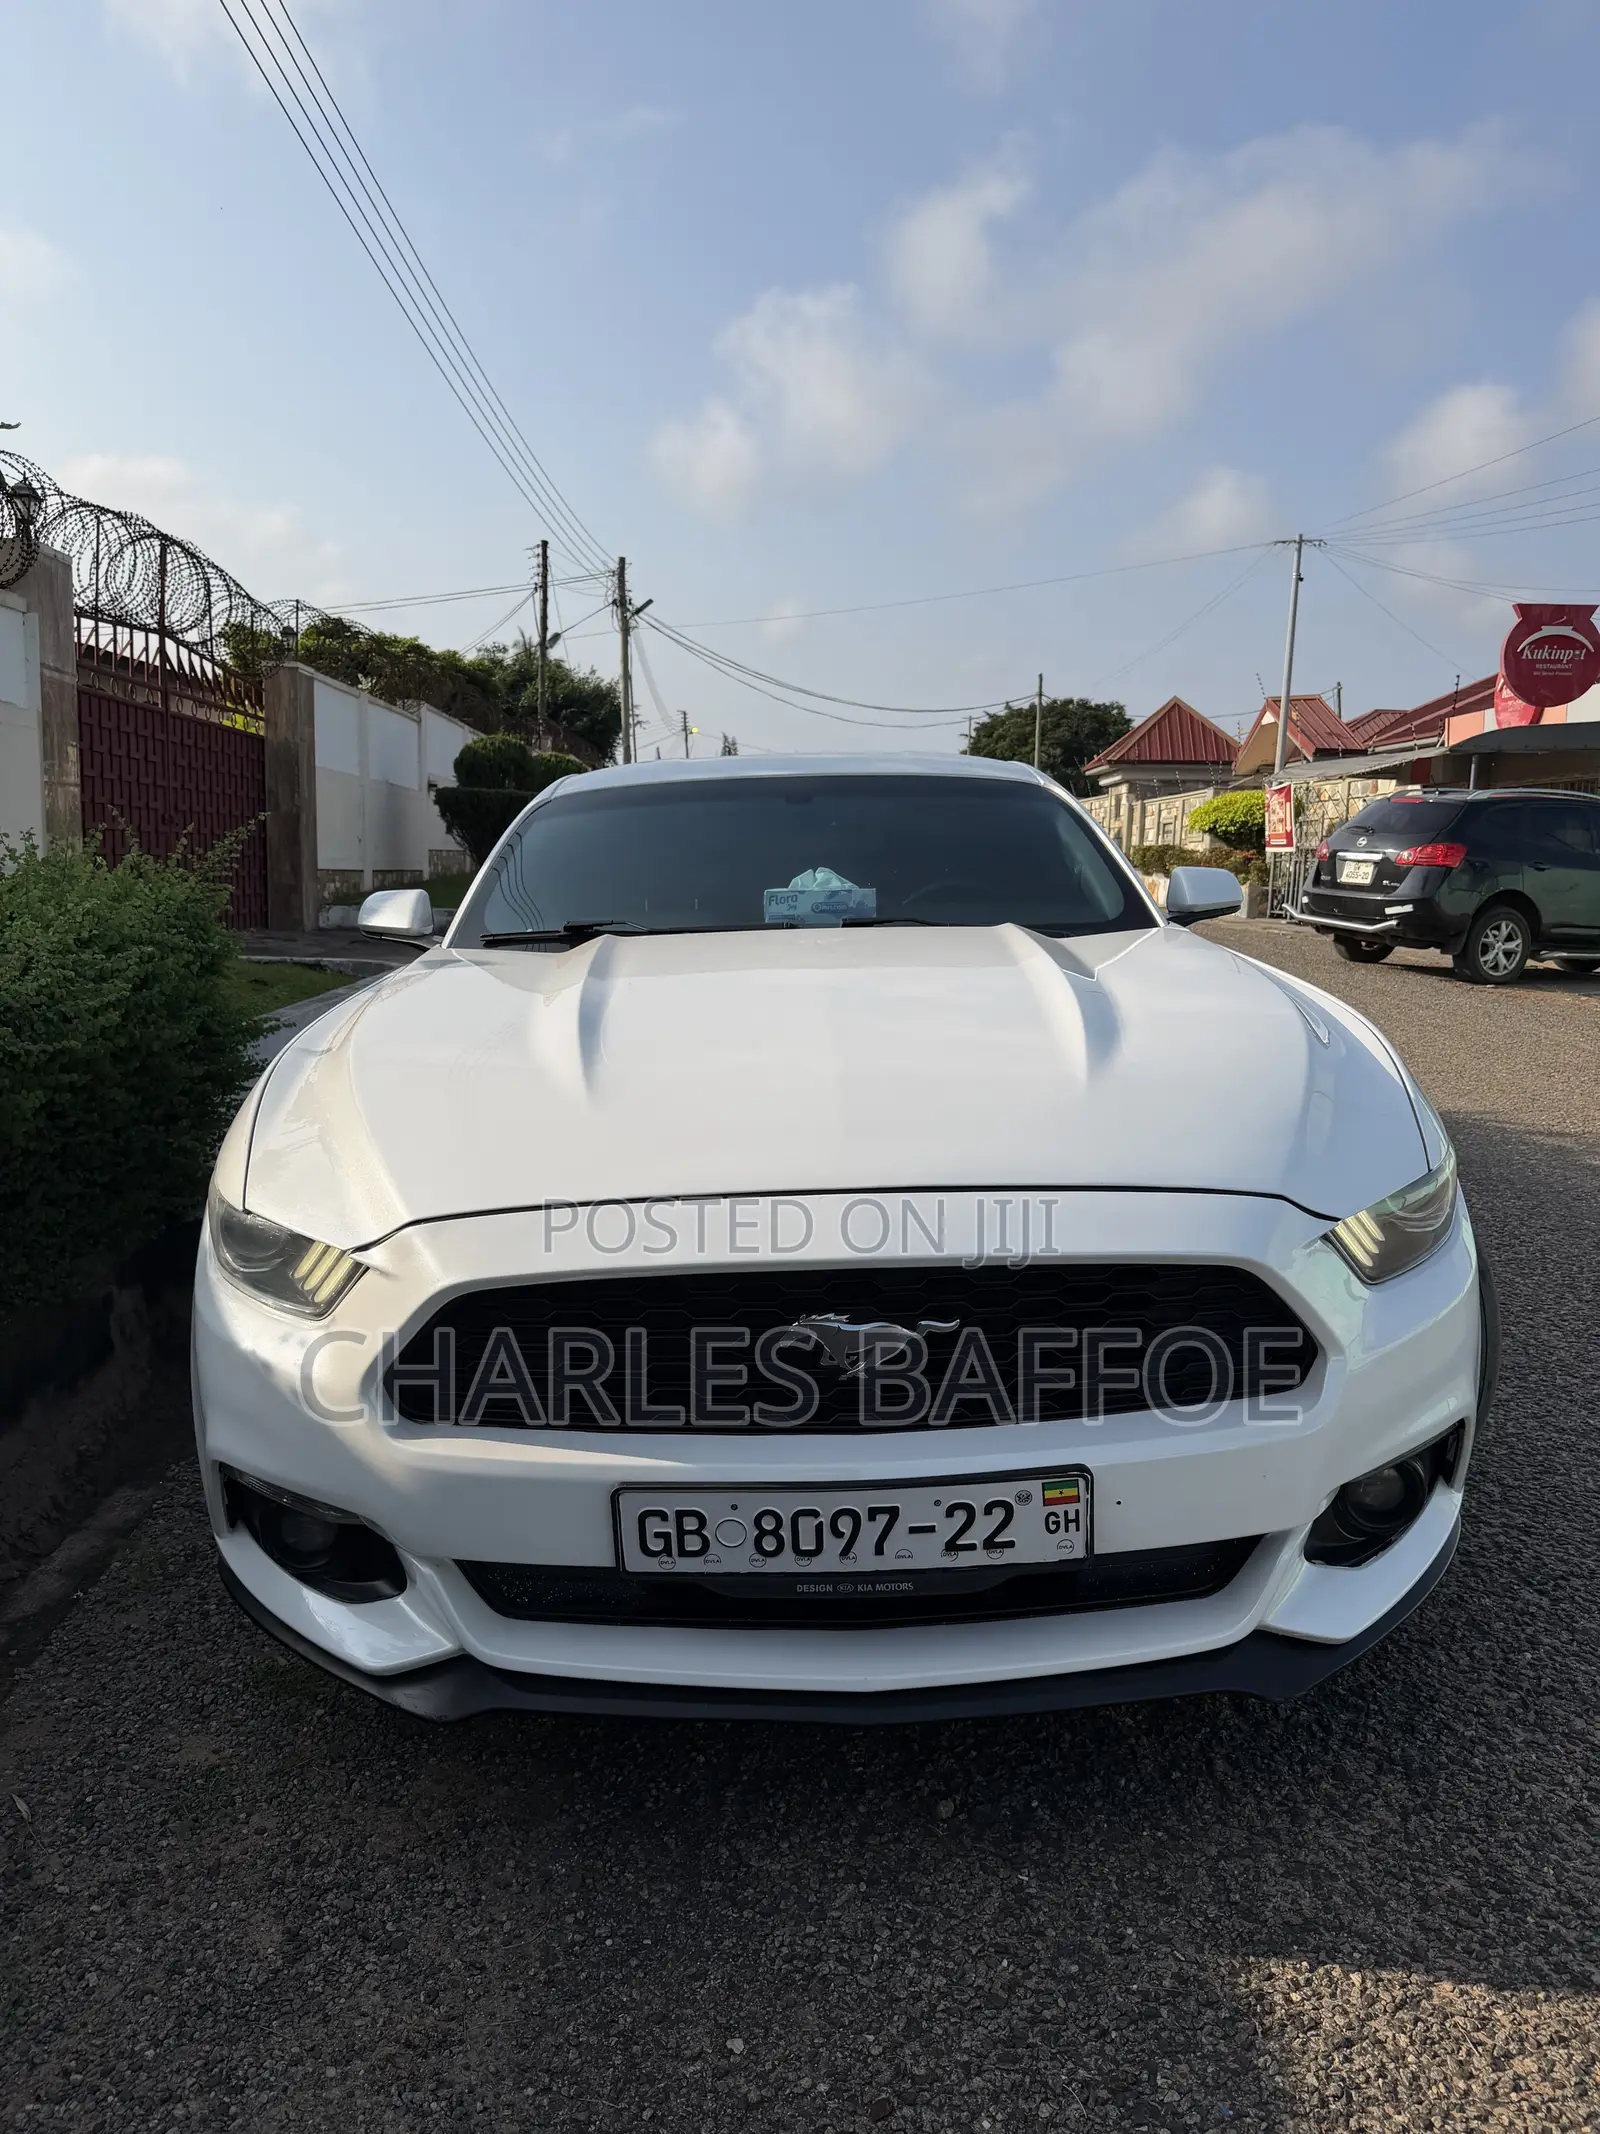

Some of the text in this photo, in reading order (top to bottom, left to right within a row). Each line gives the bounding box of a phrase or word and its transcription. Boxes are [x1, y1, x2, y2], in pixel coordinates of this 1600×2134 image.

[1521, 644, 1587, 663] Kukinpot
[768, 893, 798, 906] Flora
[637, 1499, 1017, 1558] GB 8097-22
[1044, 1508, 1081, 1535] GH
[796, 1581, 914, 1593] DESIGN KIA KIA MOTORS
